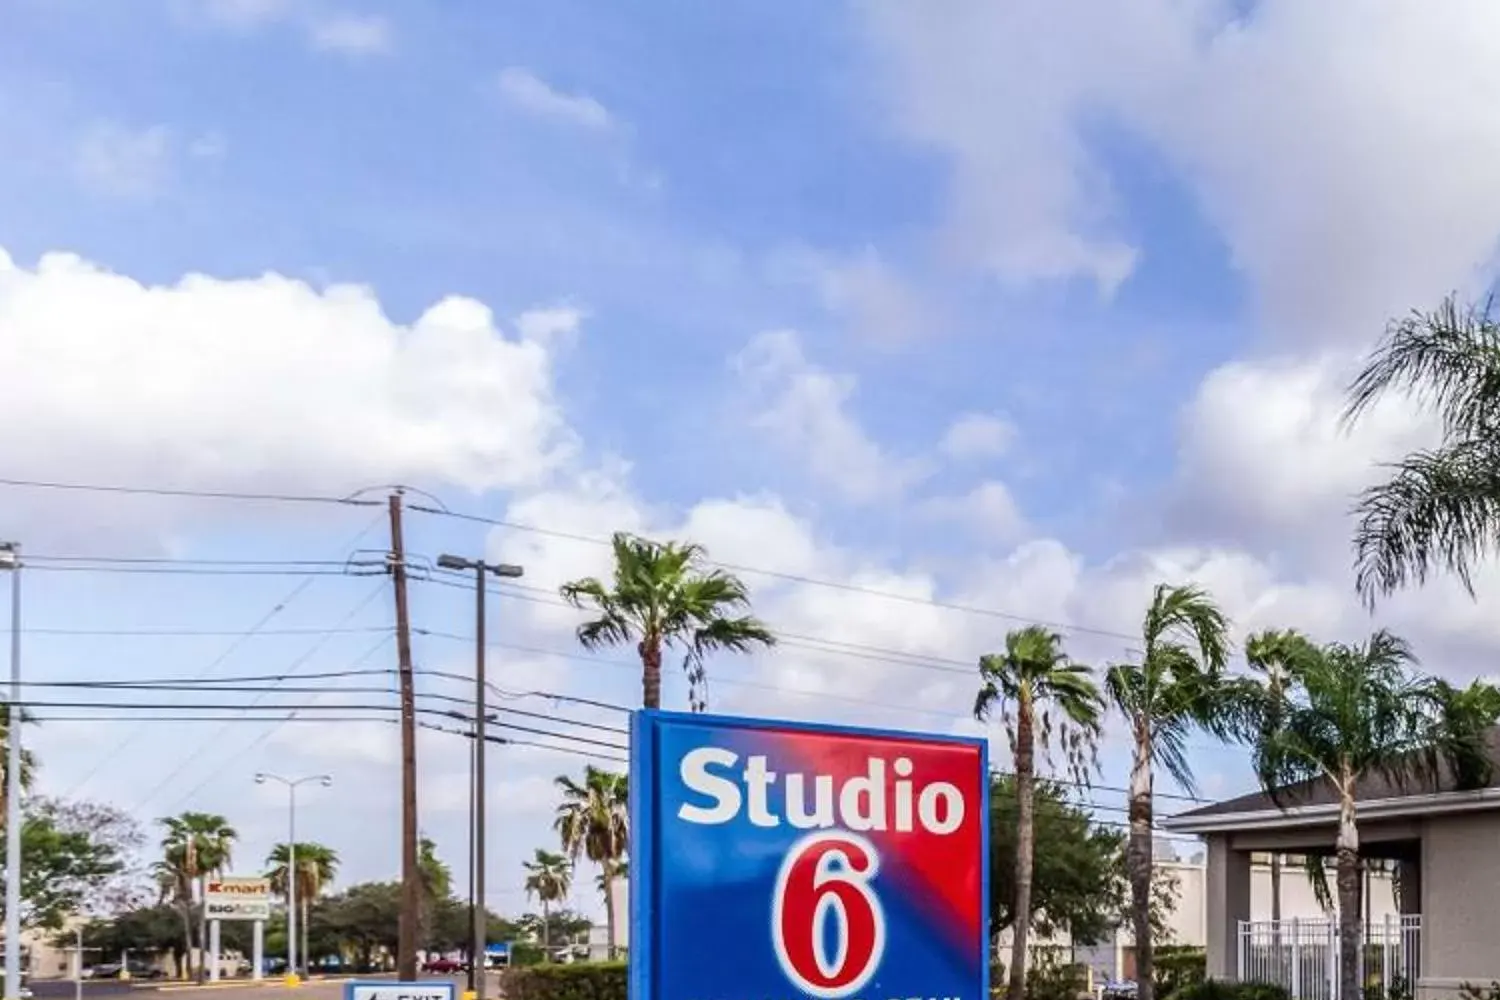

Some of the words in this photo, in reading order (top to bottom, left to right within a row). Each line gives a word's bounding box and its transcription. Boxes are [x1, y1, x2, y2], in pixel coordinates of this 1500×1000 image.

[677, 747, 965, 835] Studio
[208, 883, 266, 894] Kmart
[772, 829, 885, 999] 6
